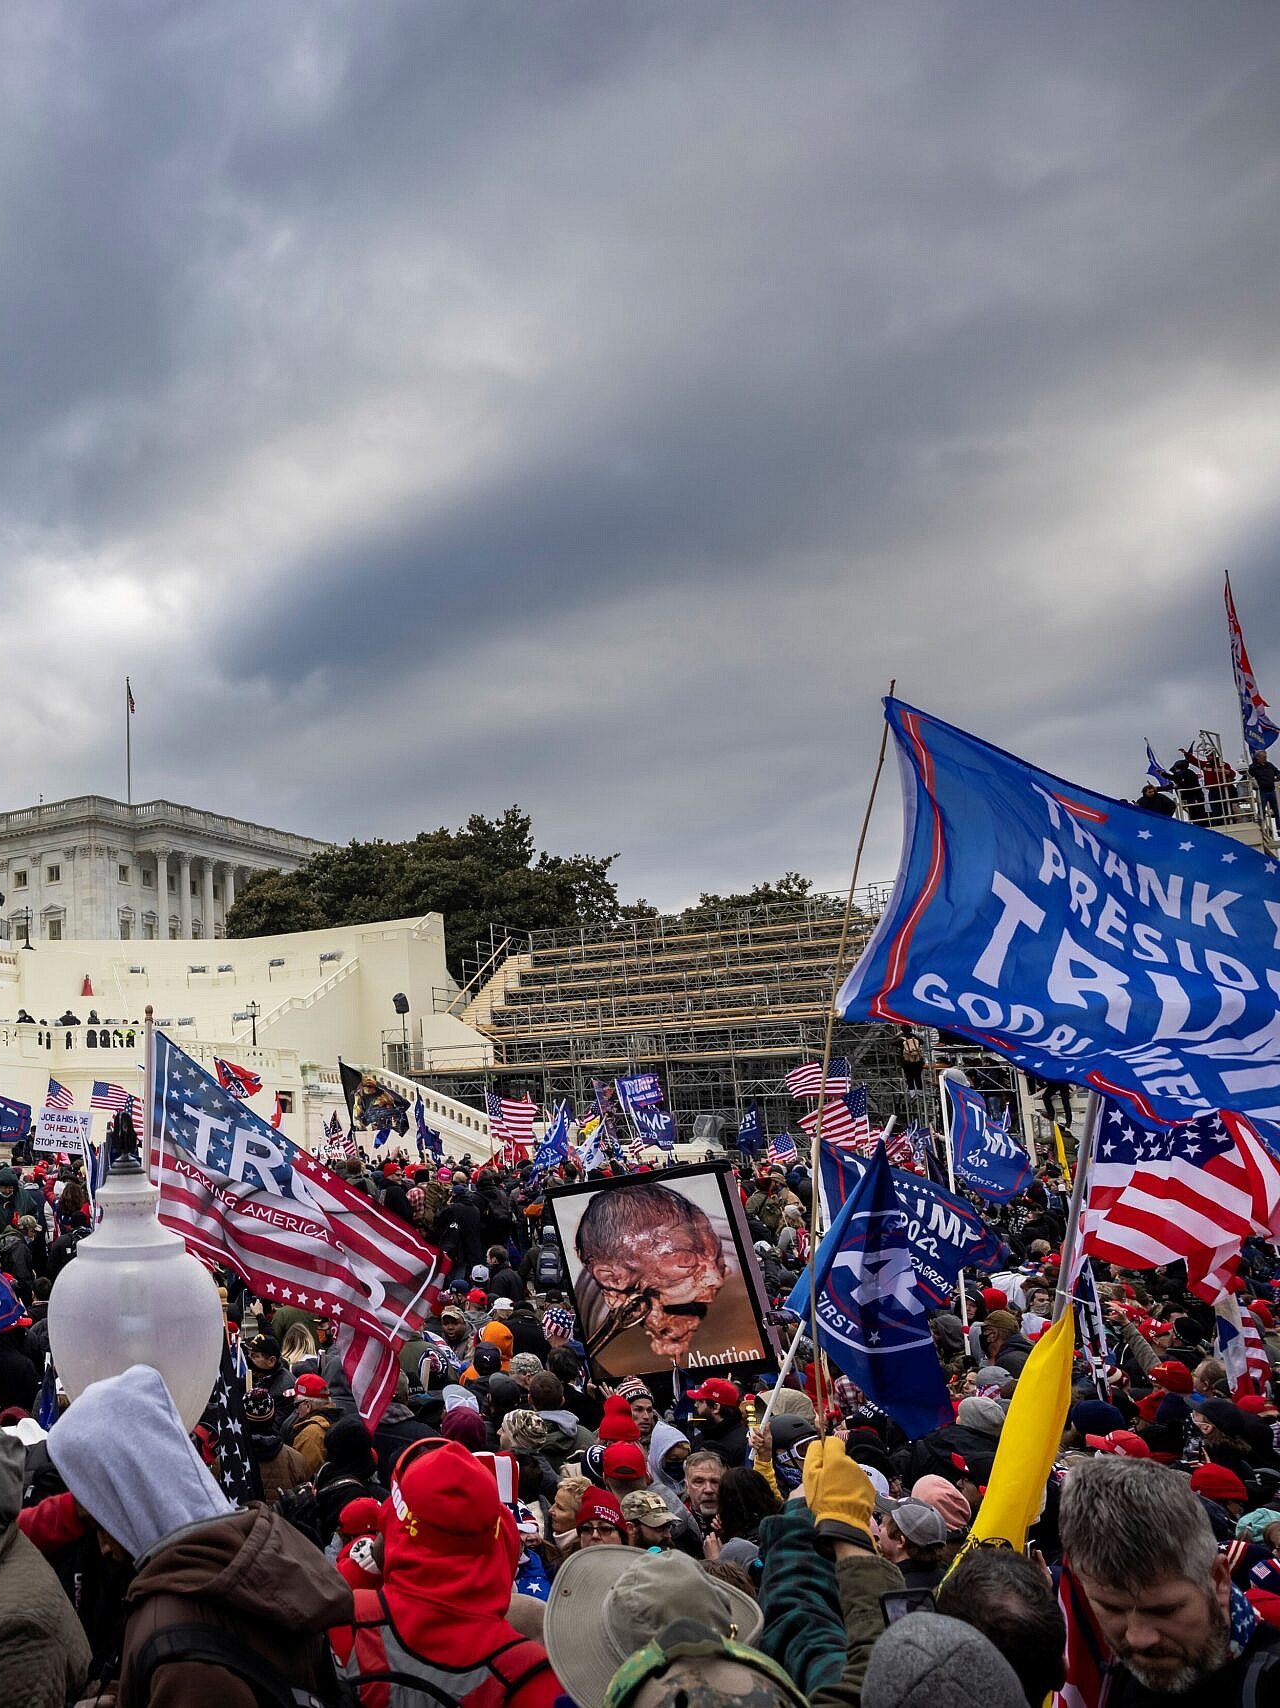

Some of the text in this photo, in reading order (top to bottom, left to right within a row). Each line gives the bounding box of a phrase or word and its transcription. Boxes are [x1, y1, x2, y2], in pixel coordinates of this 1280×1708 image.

[1031, 782, 1244, 938] THANK
[1039, 837, 1260, 991] PRESID
[913, 973, 1044, 1037] GOD
[41, 1113, 55, 1121] JOE
[44, 1123, 55, 1131] OH
[56, 1125, 73, 1133] HELL
[35, 1138, 82, 1150] STOP THE STE
[175, 1160, 330, 1243] MAKING AMERICA
[819, 1292, 858, 1335] FIRST
[688, 1346, 761, 1368] Abortion
